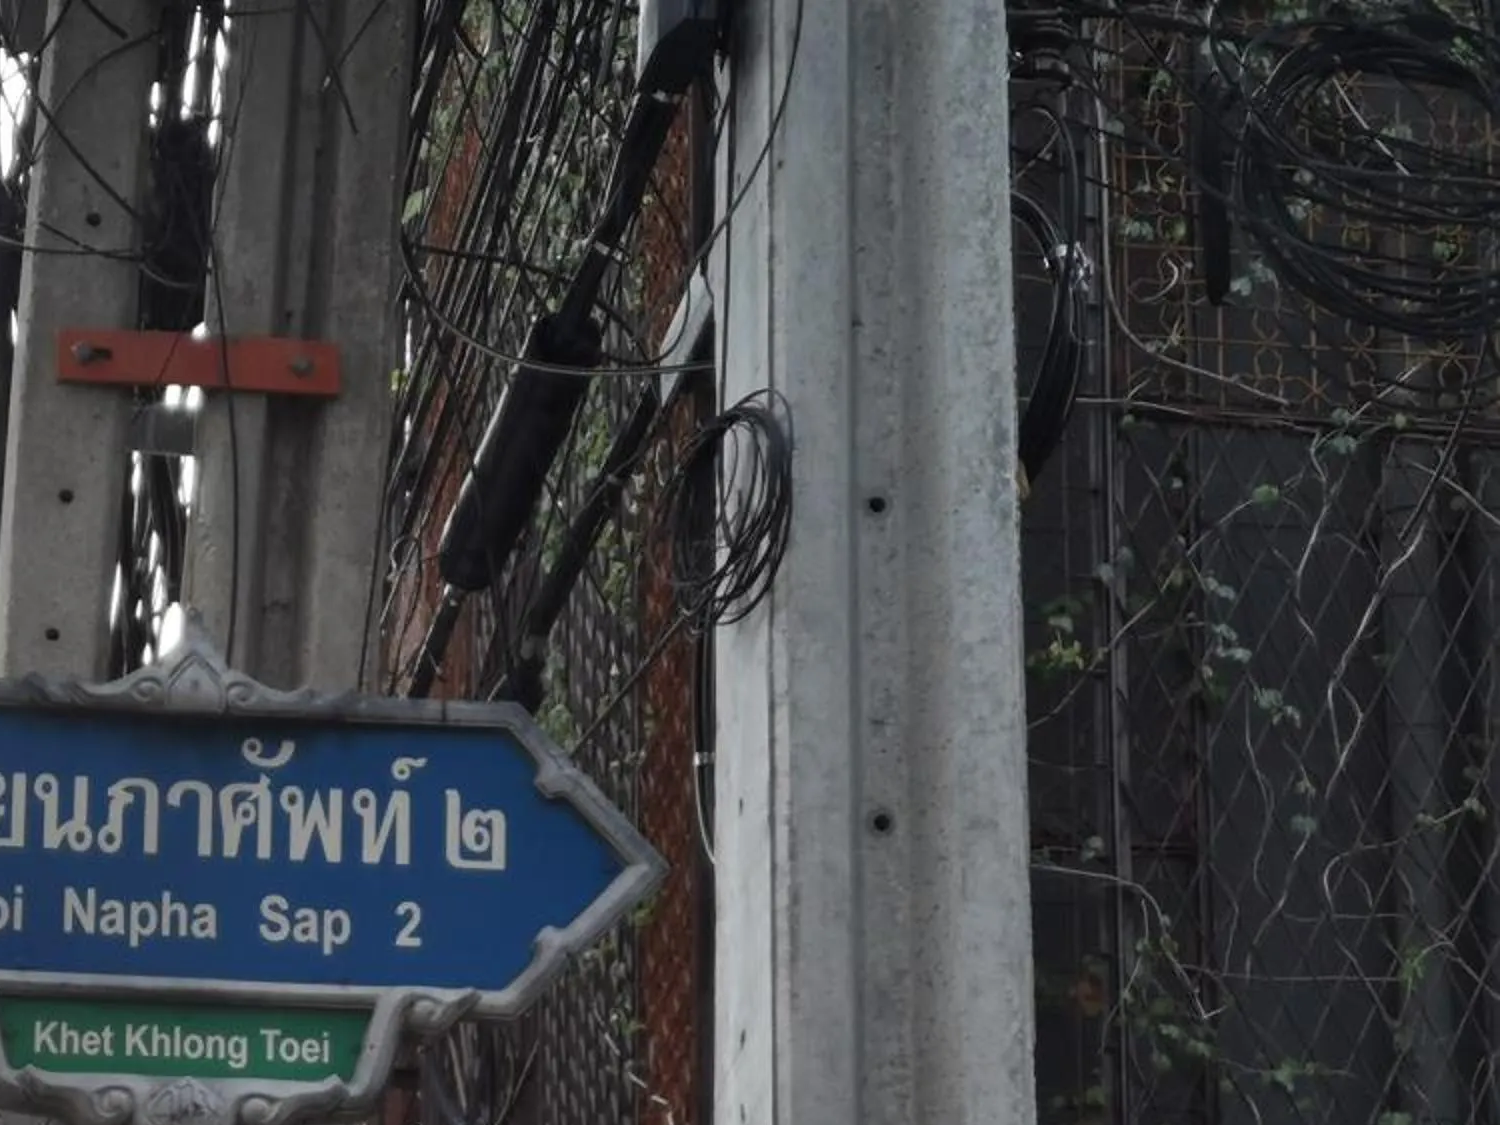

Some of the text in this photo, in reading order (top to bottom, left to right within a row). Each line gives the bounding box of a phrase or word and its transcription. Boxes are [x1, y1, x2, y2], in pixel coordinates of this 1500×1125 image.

[445, 788, 507, 871] ๒
[63, 886, 218, 947] Napha
[258, 894, 351, 955] Sap
[394, 901, 423, 948] 2
[33, 1020, 331, 1069] Khet Khlong Toei
